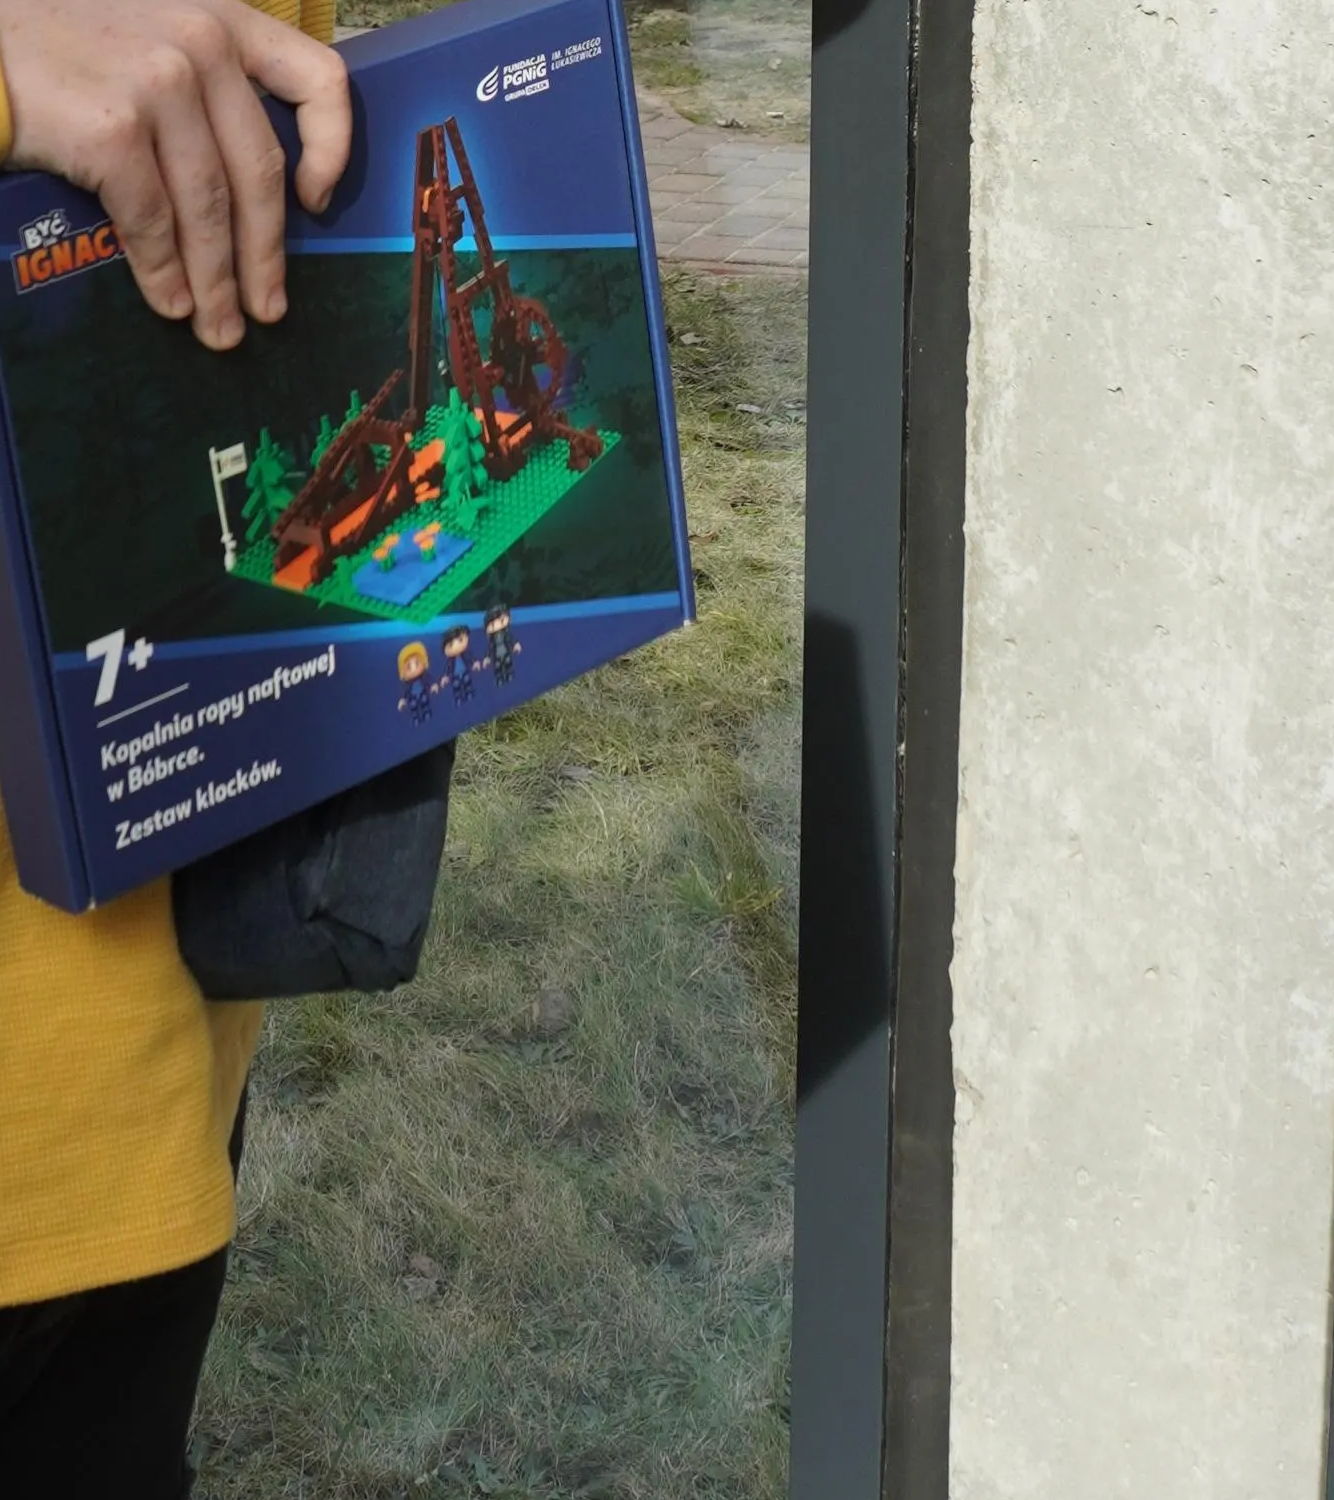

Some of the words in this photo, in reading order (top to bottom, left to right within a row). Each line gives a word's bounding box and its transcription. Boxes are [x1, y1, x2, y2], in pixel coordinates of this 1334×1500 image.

[503, 54, 546, 75] FUNDACJA
[565, 37, 602, 57] IGNACEGO
[503, 61, 547, 90] PGNiG
[23, 212, 66, 249] BYĆ
[85, 628, 154, 707] 7+
[101, 710, 195, 771] Kopalnia
[197, 690, 245, 729] ropy
[247, 644, 336, 706] naftowej
[106, 781, 125, 803] w
[128, 744, 205, 795] Bóbrce.
[115, 801, 193, 850] Zestaw
[195, 756, 283, 811] klocków.
